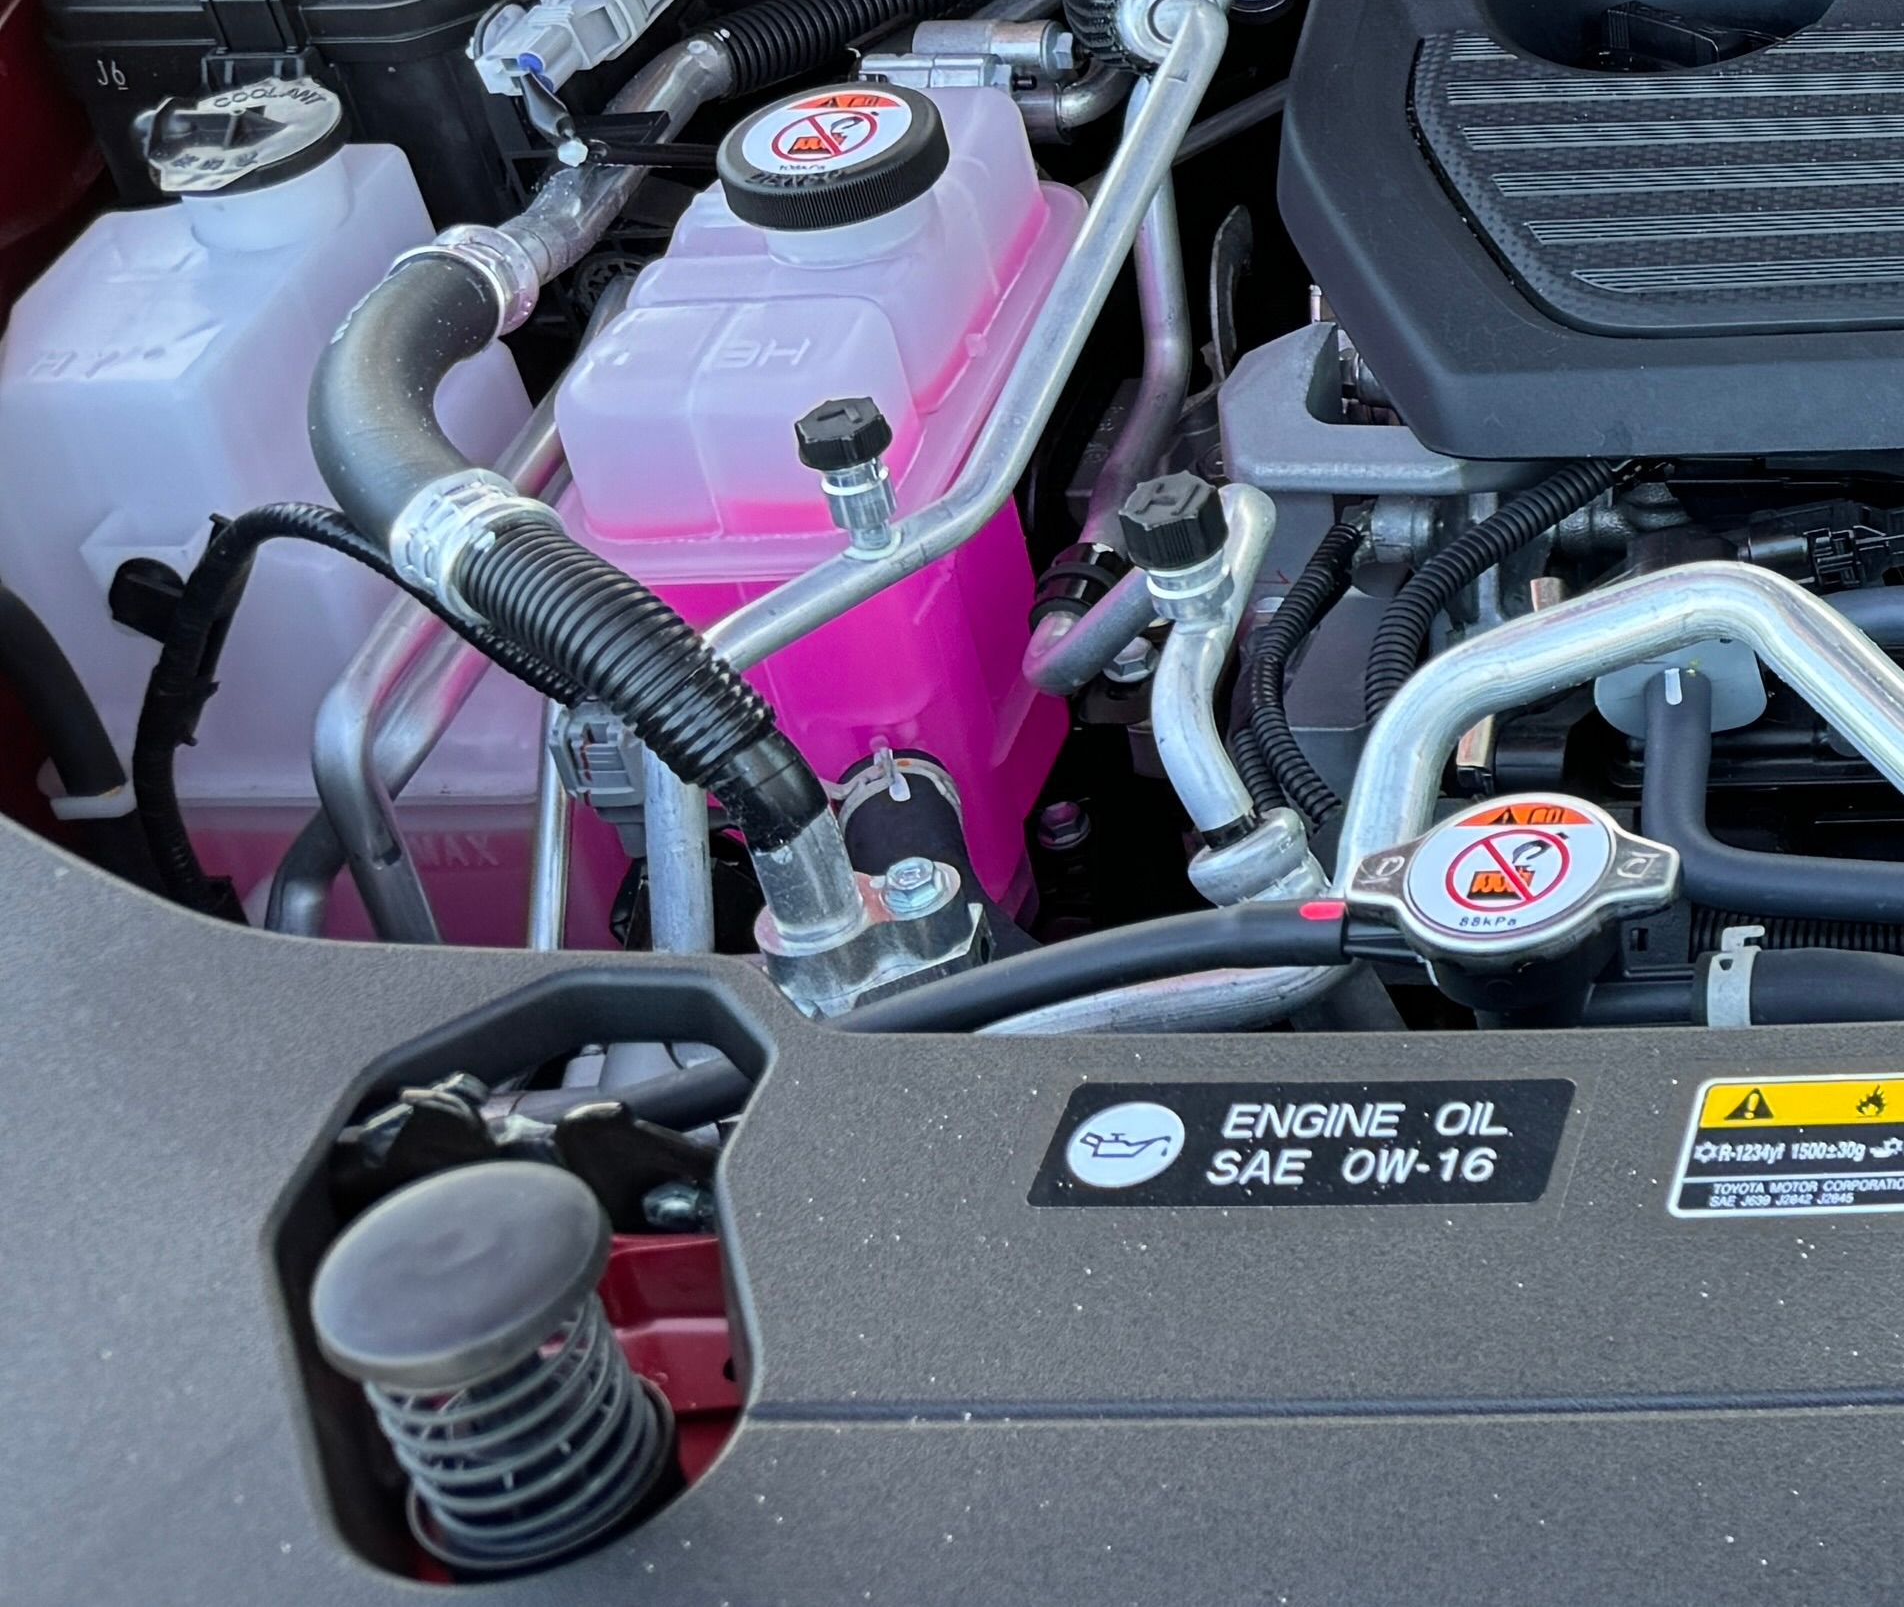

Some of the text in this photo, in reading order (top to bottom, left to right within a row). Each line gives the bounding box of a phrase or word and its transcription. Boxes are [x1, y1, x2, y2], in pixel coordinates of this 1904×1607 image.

[213, 85, 328, 109] COOLANT
[1457, 914, 1518, 928] 88kPa
[1220, 1100, 1509, 1139] ENGINE OIL
[1717, 1141, 1786, 1165] R-1234yf
[1790, 1140, 1867, 1163] 1500±30g
[1206, 1146, 1498, 1186] SAE 0W-16
[1712, 1181, 1766, 1195] TOYOTA
[1769, 1180, 1819, 1194] MOTOR
[1709, 1195, 1737, 1208] SAE
